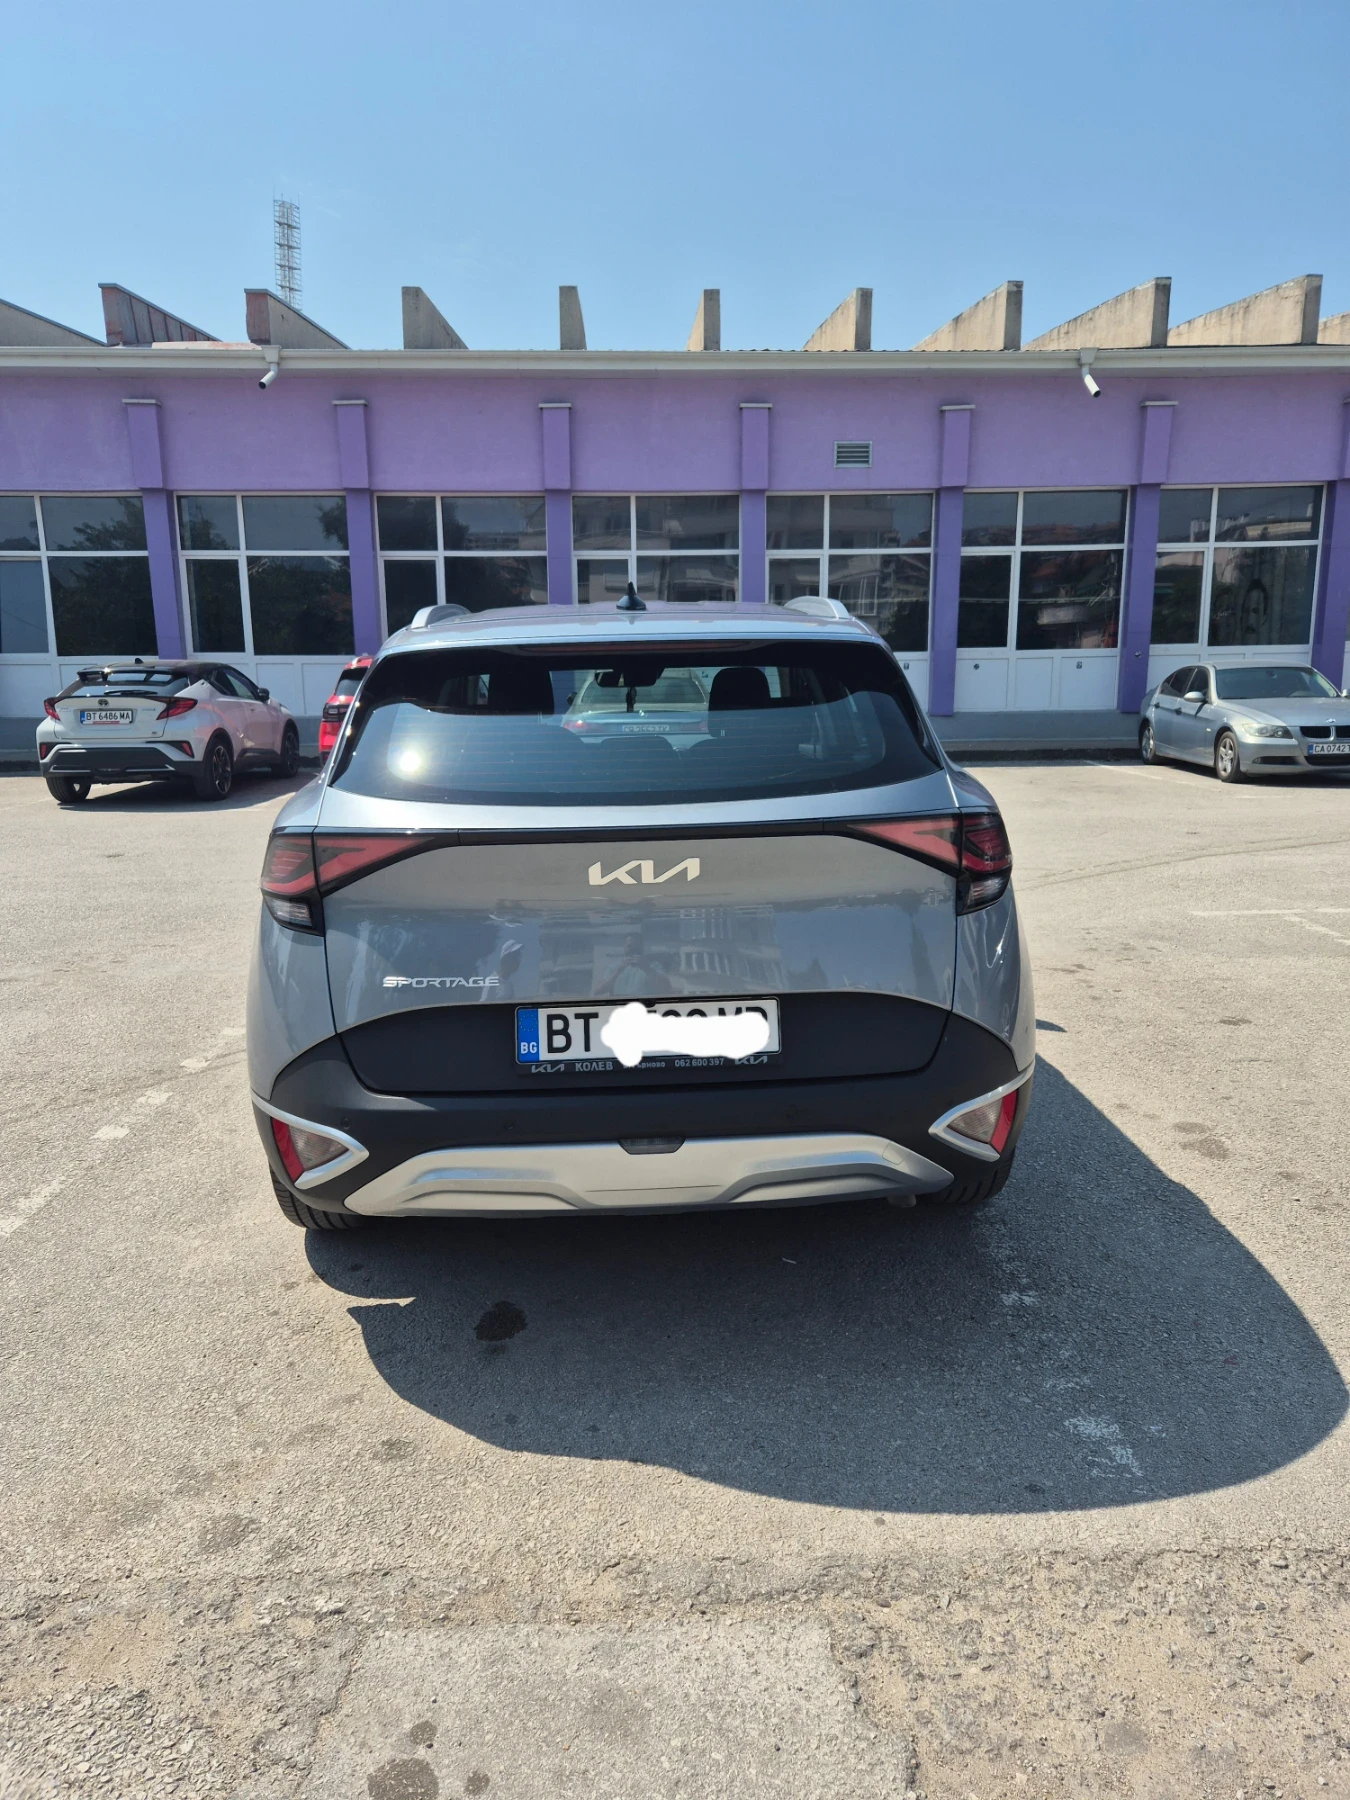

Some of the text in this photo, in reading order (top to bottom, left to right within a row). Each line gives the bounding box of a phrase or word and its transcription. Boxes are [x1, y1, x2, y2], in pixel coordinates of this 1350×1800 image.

[86, 712, 97, 720] BT
[98, 712, 119, 720] 6486
[1315, 744, 1325, 752] CA
[1326, 744, 1346, 752] 0742
[588, 857, 700, 886] KIA
[382, 975, 500, 988] SPORTAGE
[546, 1012, 599, 1054] BT
[520, 1041, 538, 1054] BG
[674, 1059, 690, 1067] 062
[691, 1058, 708, 1067] 600
[709, 1057, 725, 1066] 397
